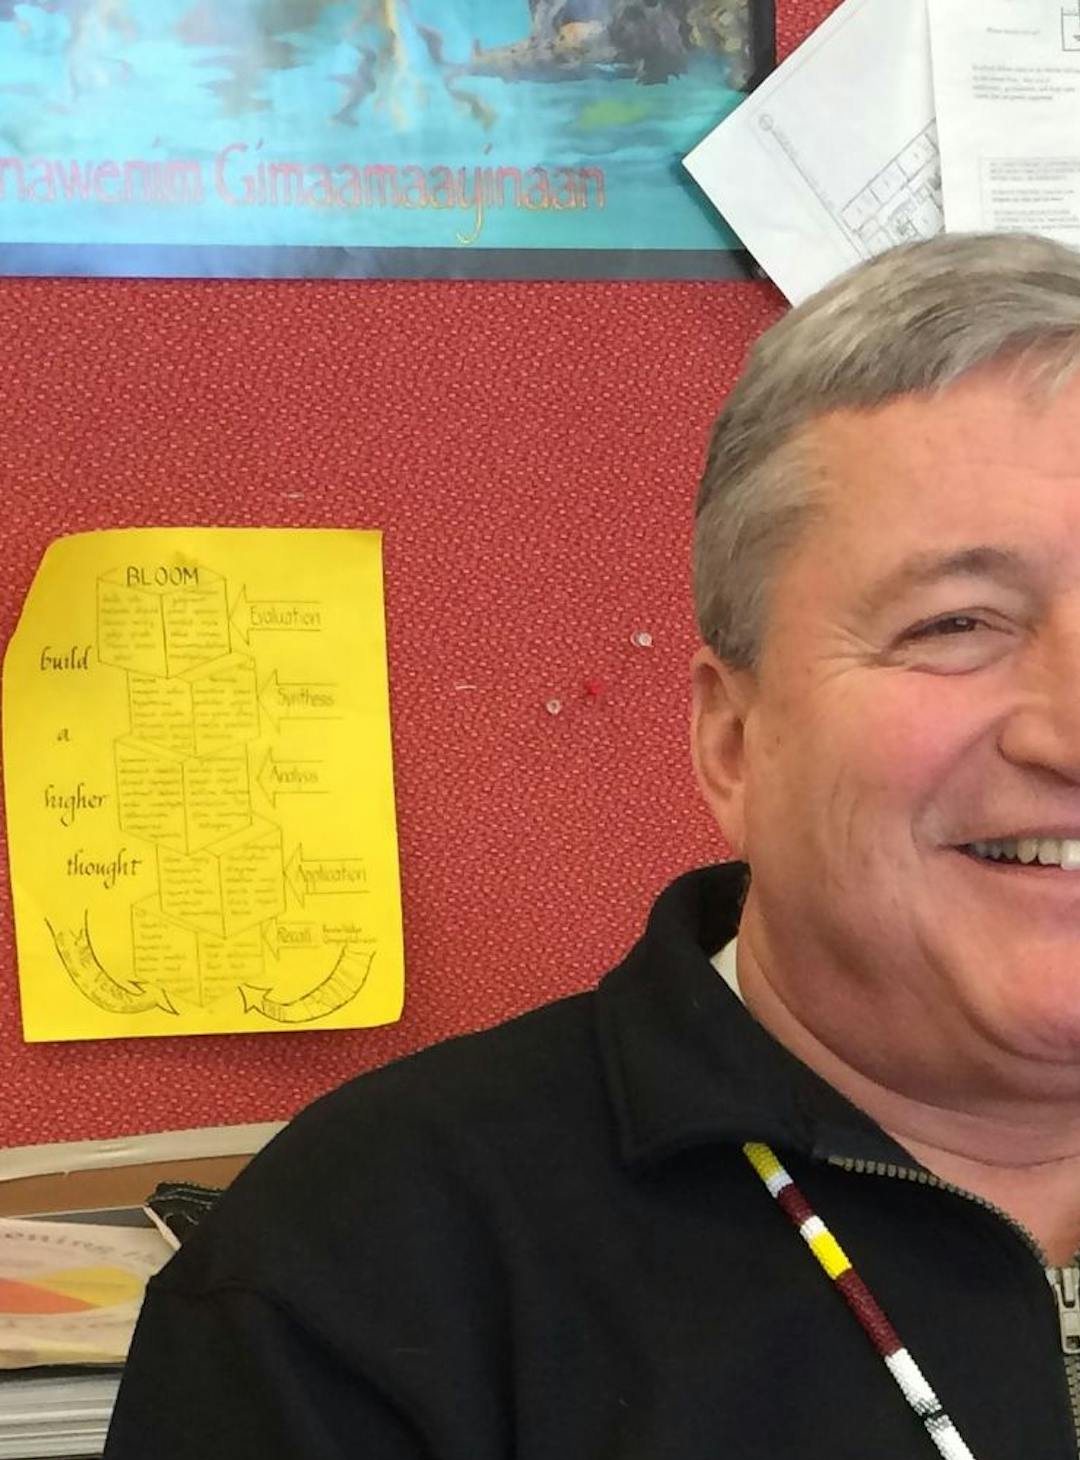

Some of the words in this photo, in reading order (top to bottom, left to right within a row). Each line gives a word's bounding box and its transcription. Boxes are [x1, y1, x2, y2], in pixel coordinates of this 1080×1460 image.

[126, 566, 200, 588] BLOOM
[250, 605, 321, 626] Evaluation
[39, 645, 90, 671] build
[57, 727, 71, 742] a
[43, 783, 108, 827] higher
[66, 847, 142, 890] thought
